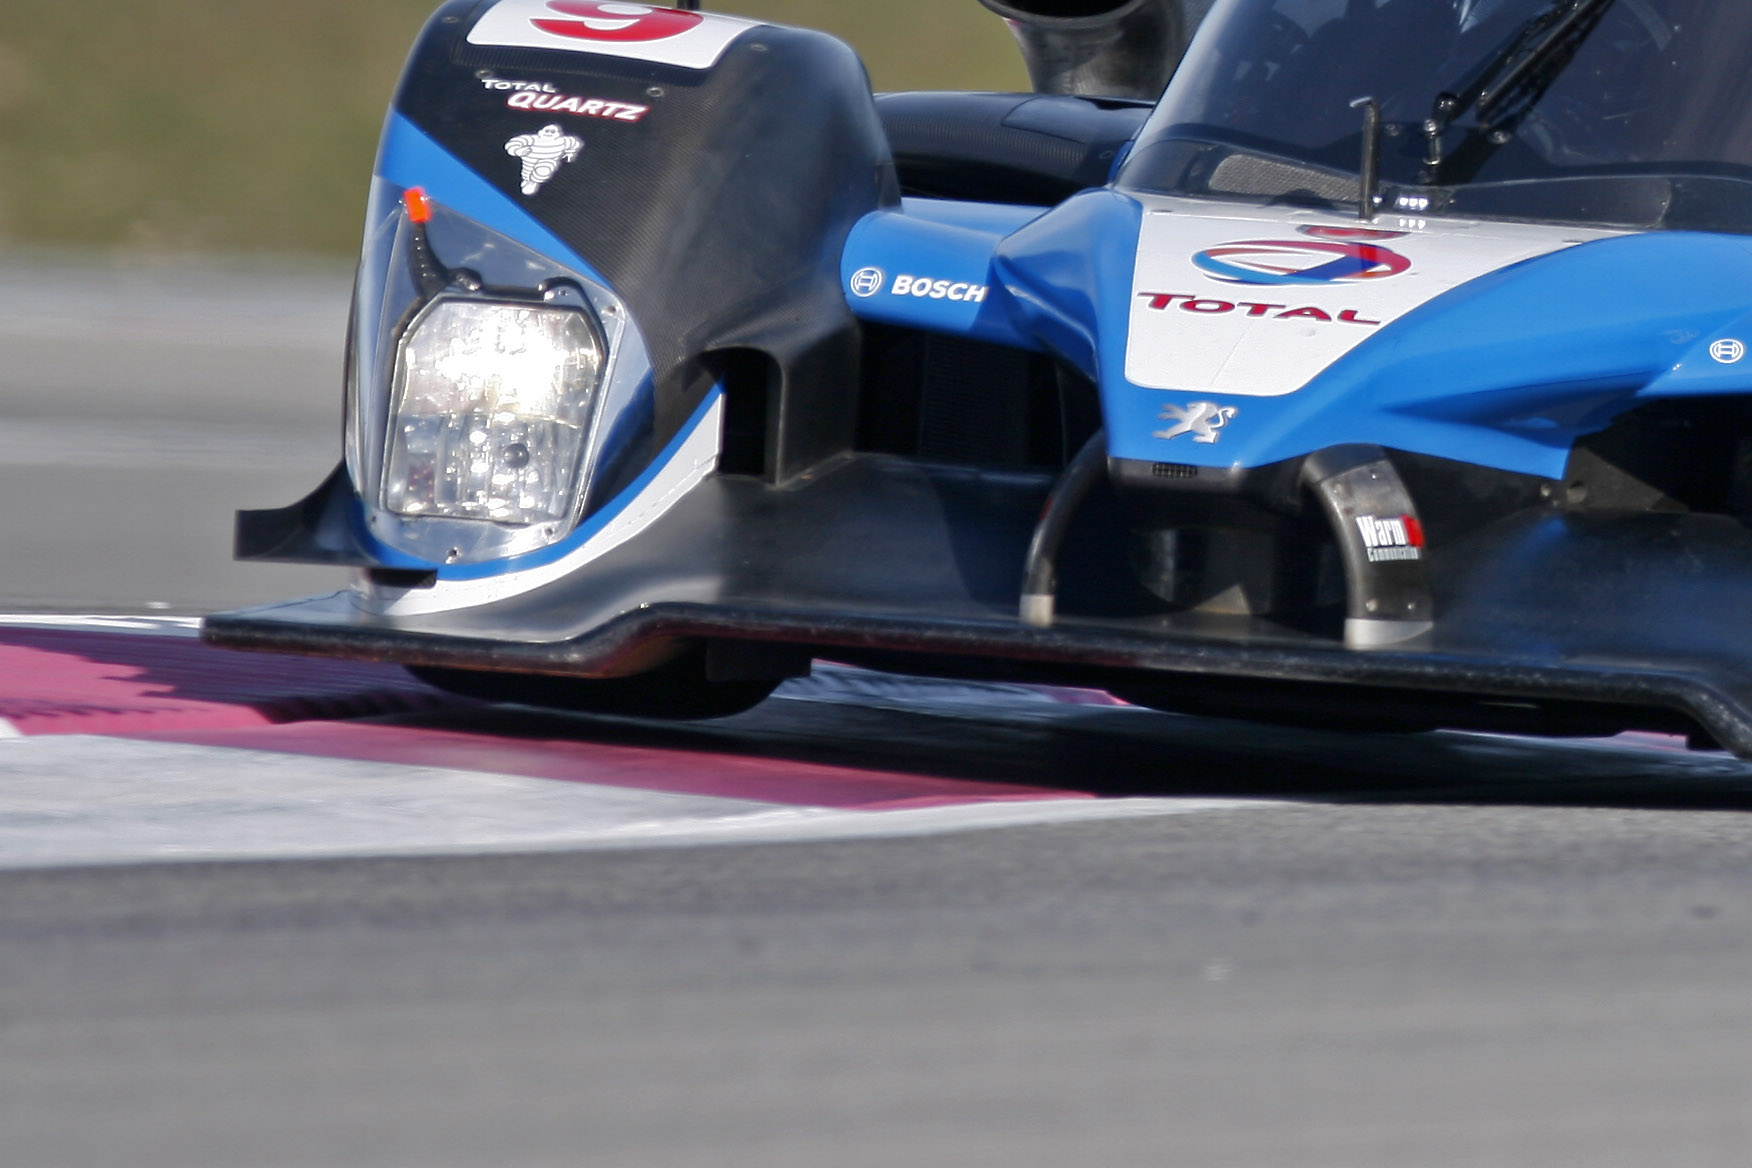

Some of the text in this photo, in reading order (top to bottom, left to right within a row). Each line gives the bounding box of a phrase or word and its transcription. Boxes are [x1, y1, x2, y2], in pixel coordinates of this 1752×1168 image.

[482, 79, 557, 93] TOTAL
[507, 91, 646, 120] QUARTZ
[891, 275, 986, 302] BOSCH
[1137, 292, 1381, 325] TOTAL
[1356, 515, 1406, 548] Warm
